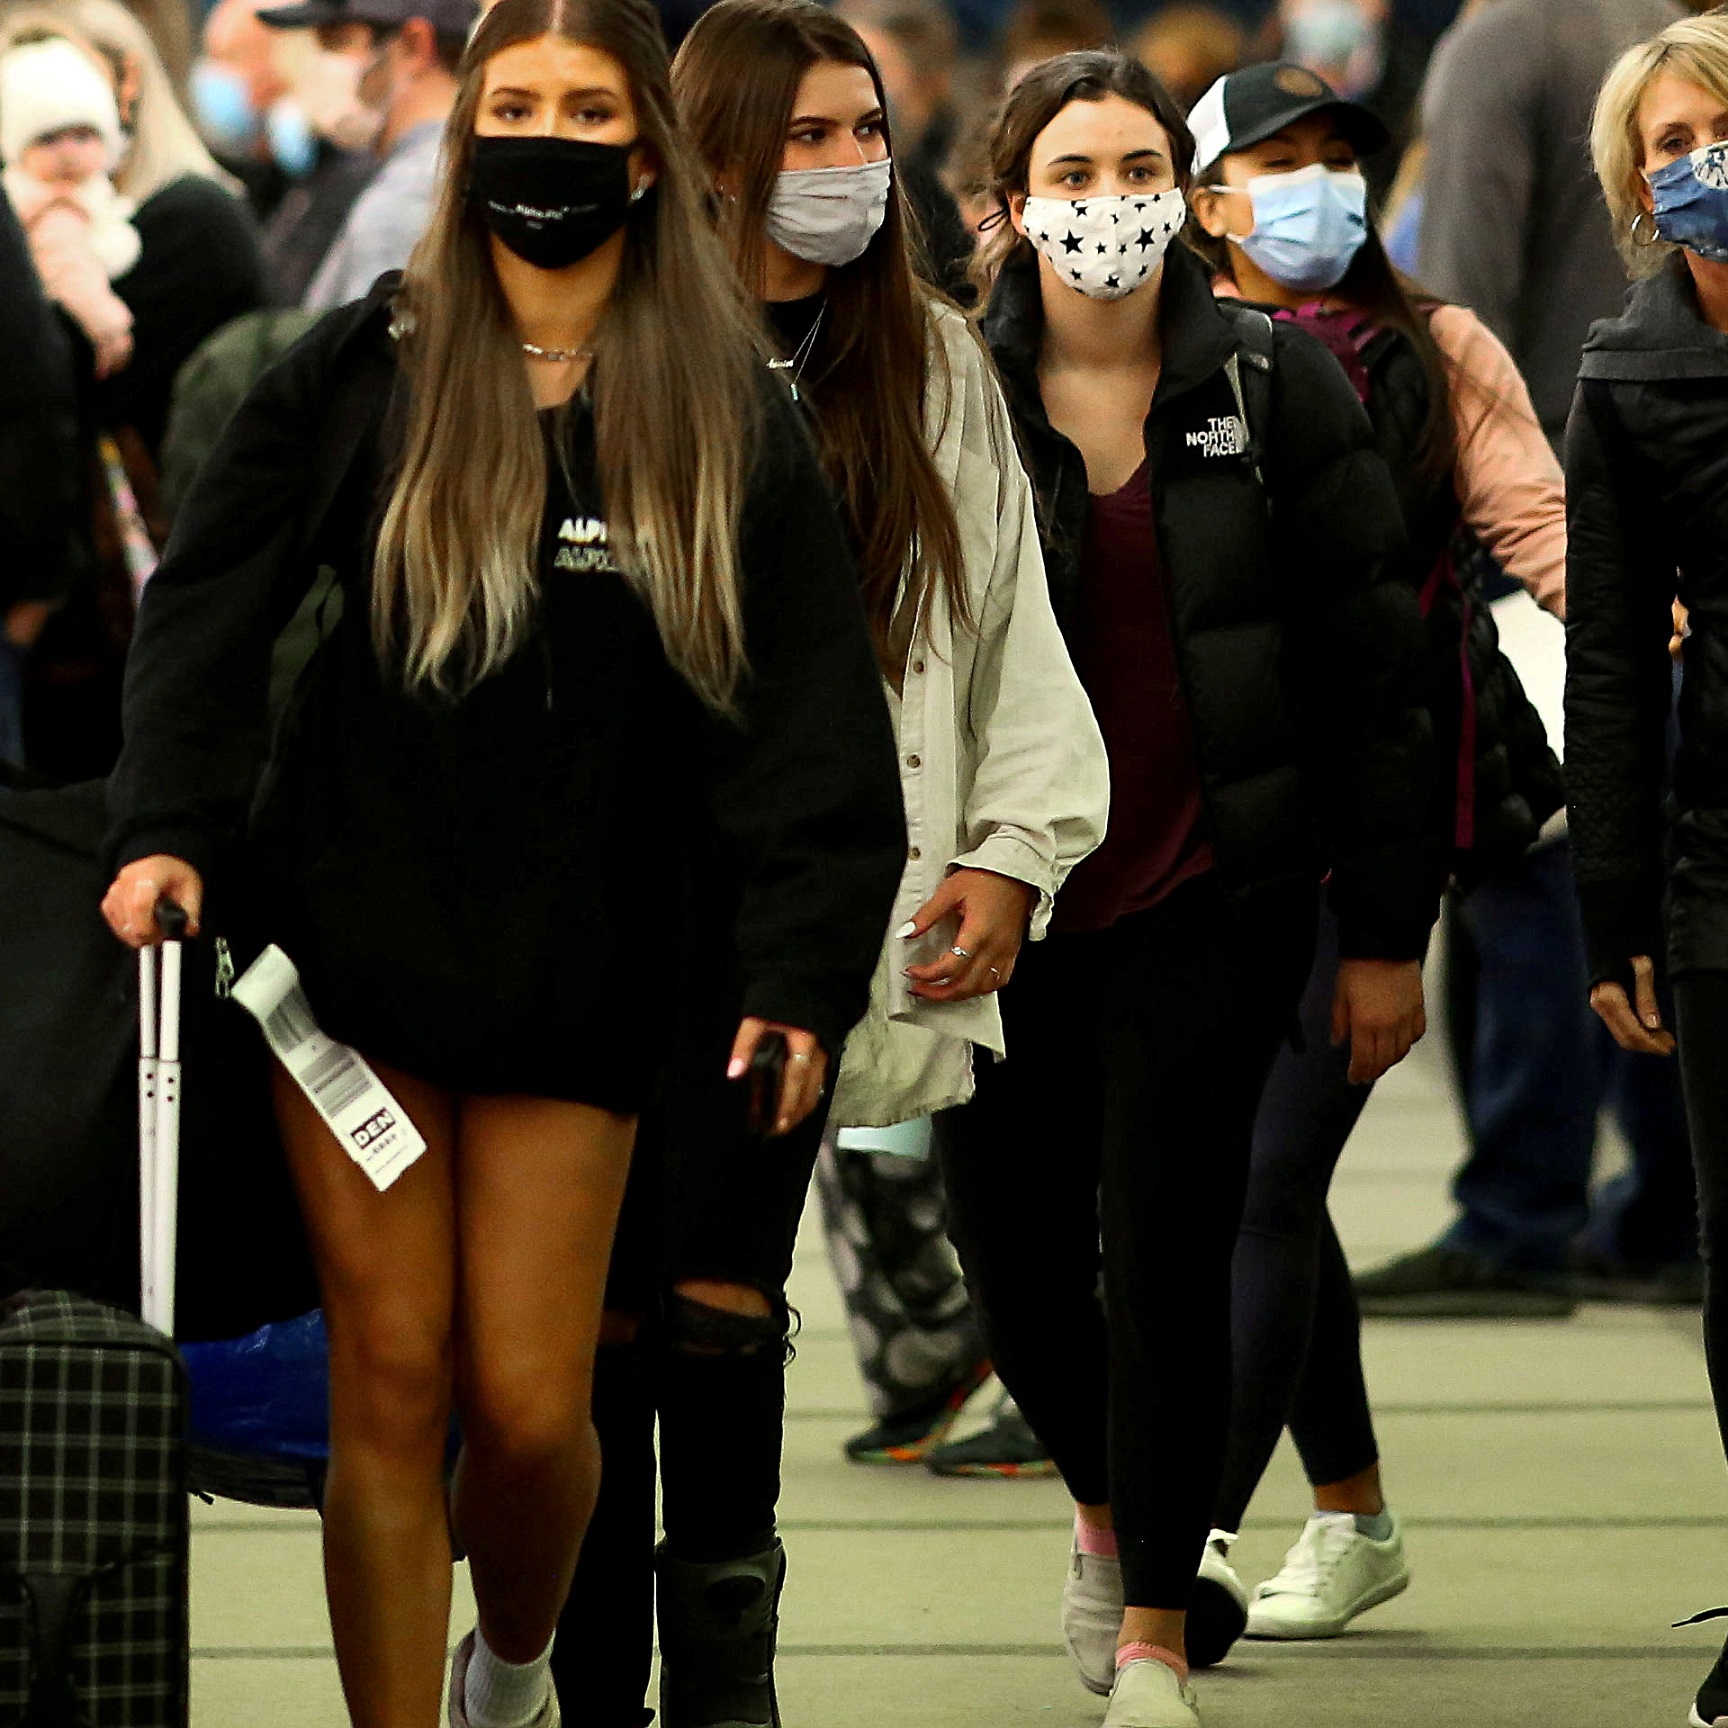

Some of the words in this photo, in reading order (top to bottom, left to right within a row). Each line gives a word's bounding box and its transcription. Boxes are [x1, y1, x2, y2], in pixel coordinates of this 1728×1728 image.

[1207, 415, 1235, 432] THE
[1186, 430, 1235, 447] NORTH
[1203, 441, 1236, 458] FACE
[351, 1106, 396, 1149] DEN
